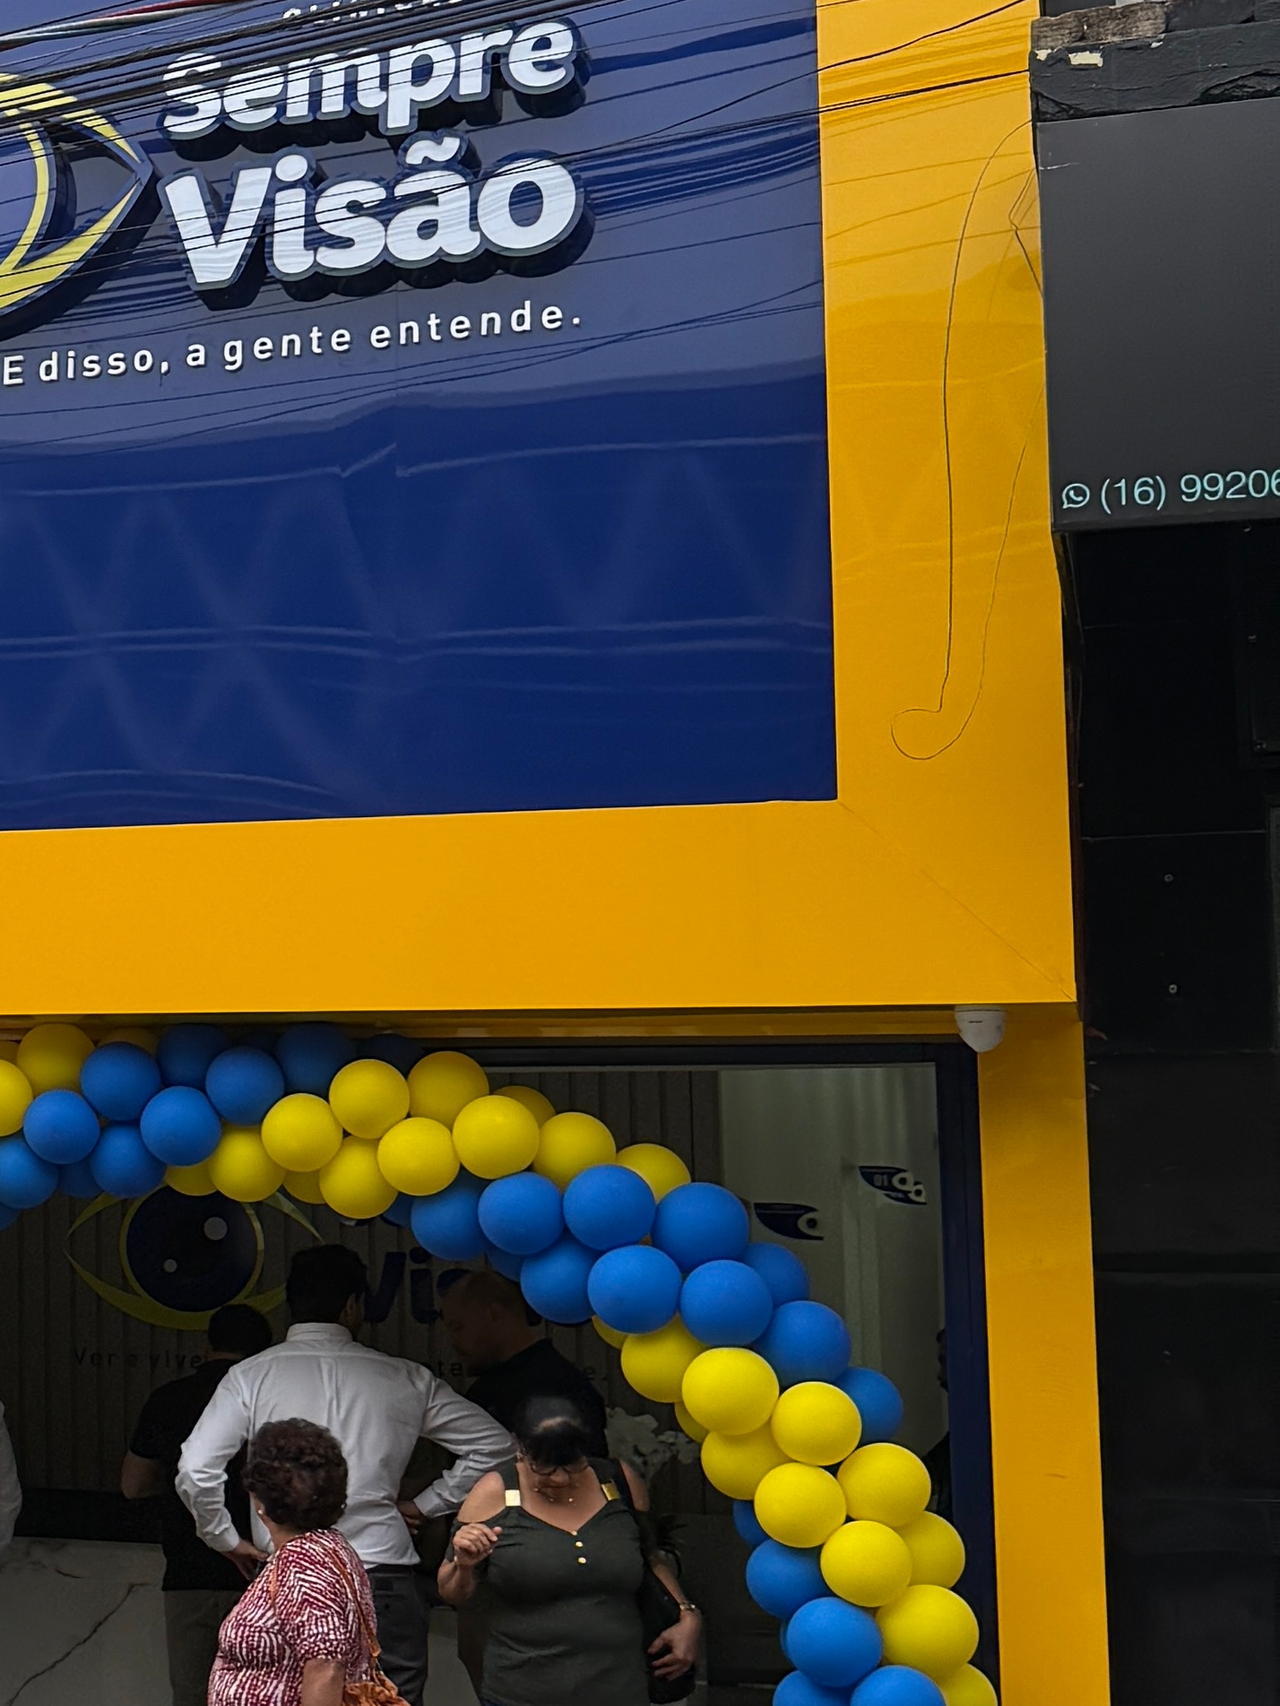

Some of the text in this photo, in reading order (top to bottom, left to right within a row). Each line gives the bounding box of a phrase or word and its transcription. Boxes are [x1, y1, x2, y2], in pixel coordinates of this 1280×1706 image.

[160, 19, 576, 134] Sempre
[163, 135, 578, 285] Visão
[3, 354, 25, 386] E
[39, 348, 170, 382] disso,
[186, 343, 206, 367] a
[223, 325, 351, 371] gente
[369, 299, 581, 349] entende.
[1100, 474, 1167, 514] (16)
